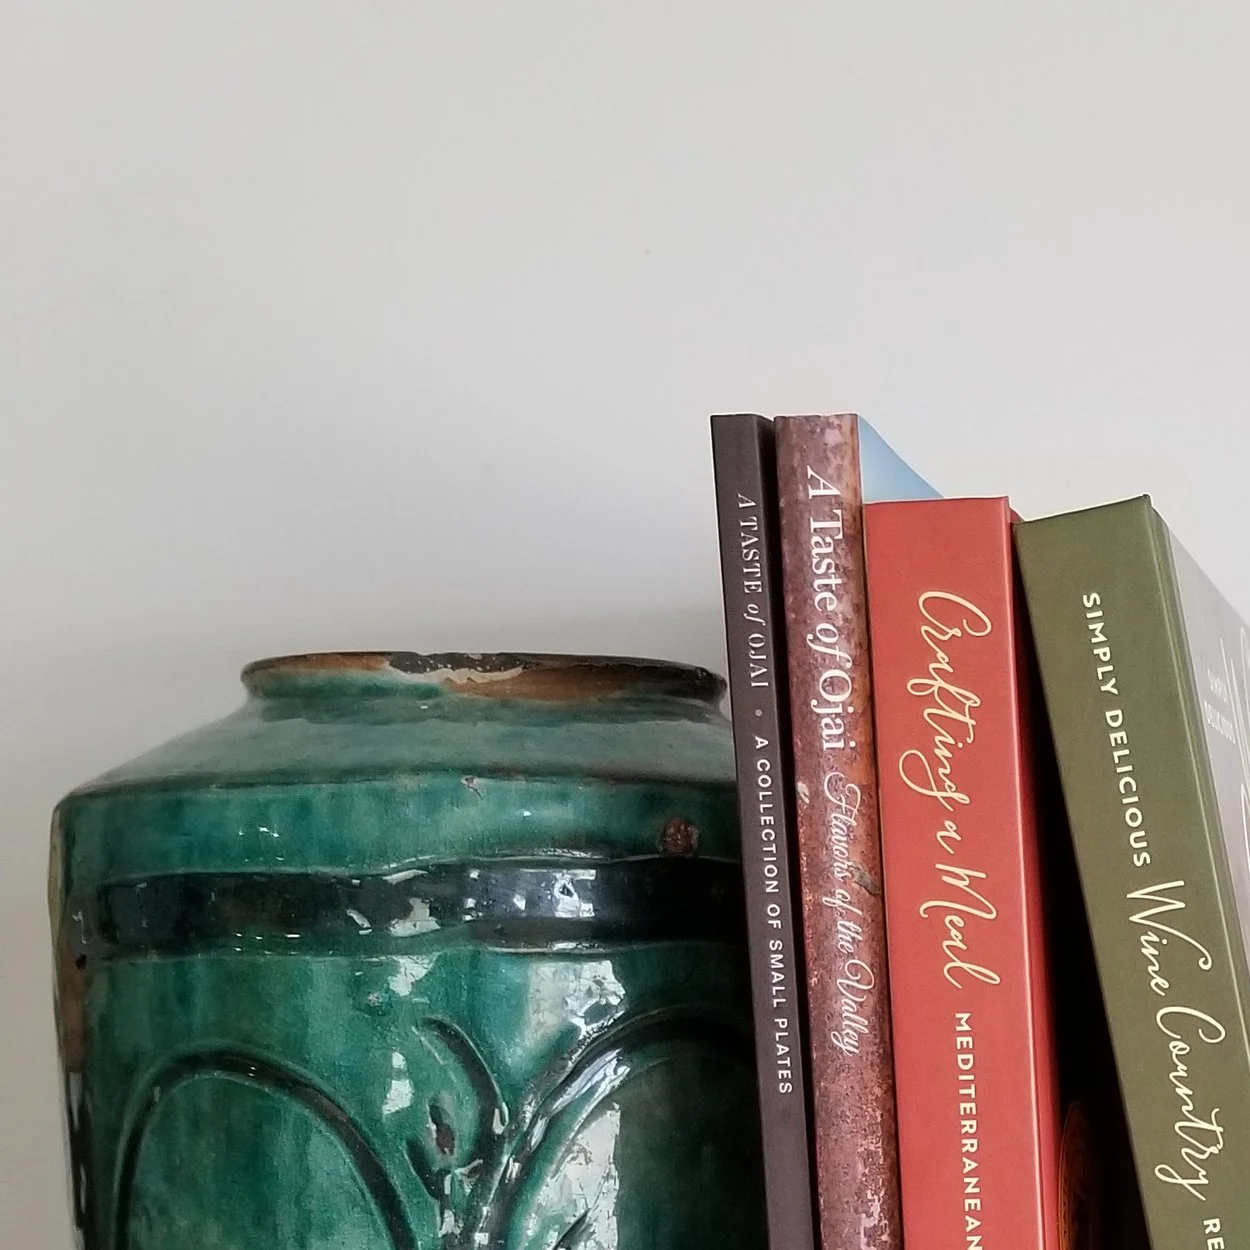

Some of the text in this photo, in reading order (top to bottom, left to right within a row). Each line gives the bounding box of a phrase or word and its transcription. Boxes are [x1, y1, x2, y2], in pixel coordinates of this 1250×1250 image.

[898, 590, 992, 812] Crafting
[1082, 592, 1119, 696] SIMPLY
[737, 493, 794, 1095] A TASTE of OJAI A COLLECTION OF SMALL PLATES
[806, 465, 875, 1058] A Taste of Ojai Flavors of the Valley
[936, 819, 962, 855] a
[1105, 708, 1151, 868] DELICIOUS
[919, 862, 1001, 990] Meal
[1126, 880, 1213, 996] Wine
[1154, 1005, 1227, 1202] Country
